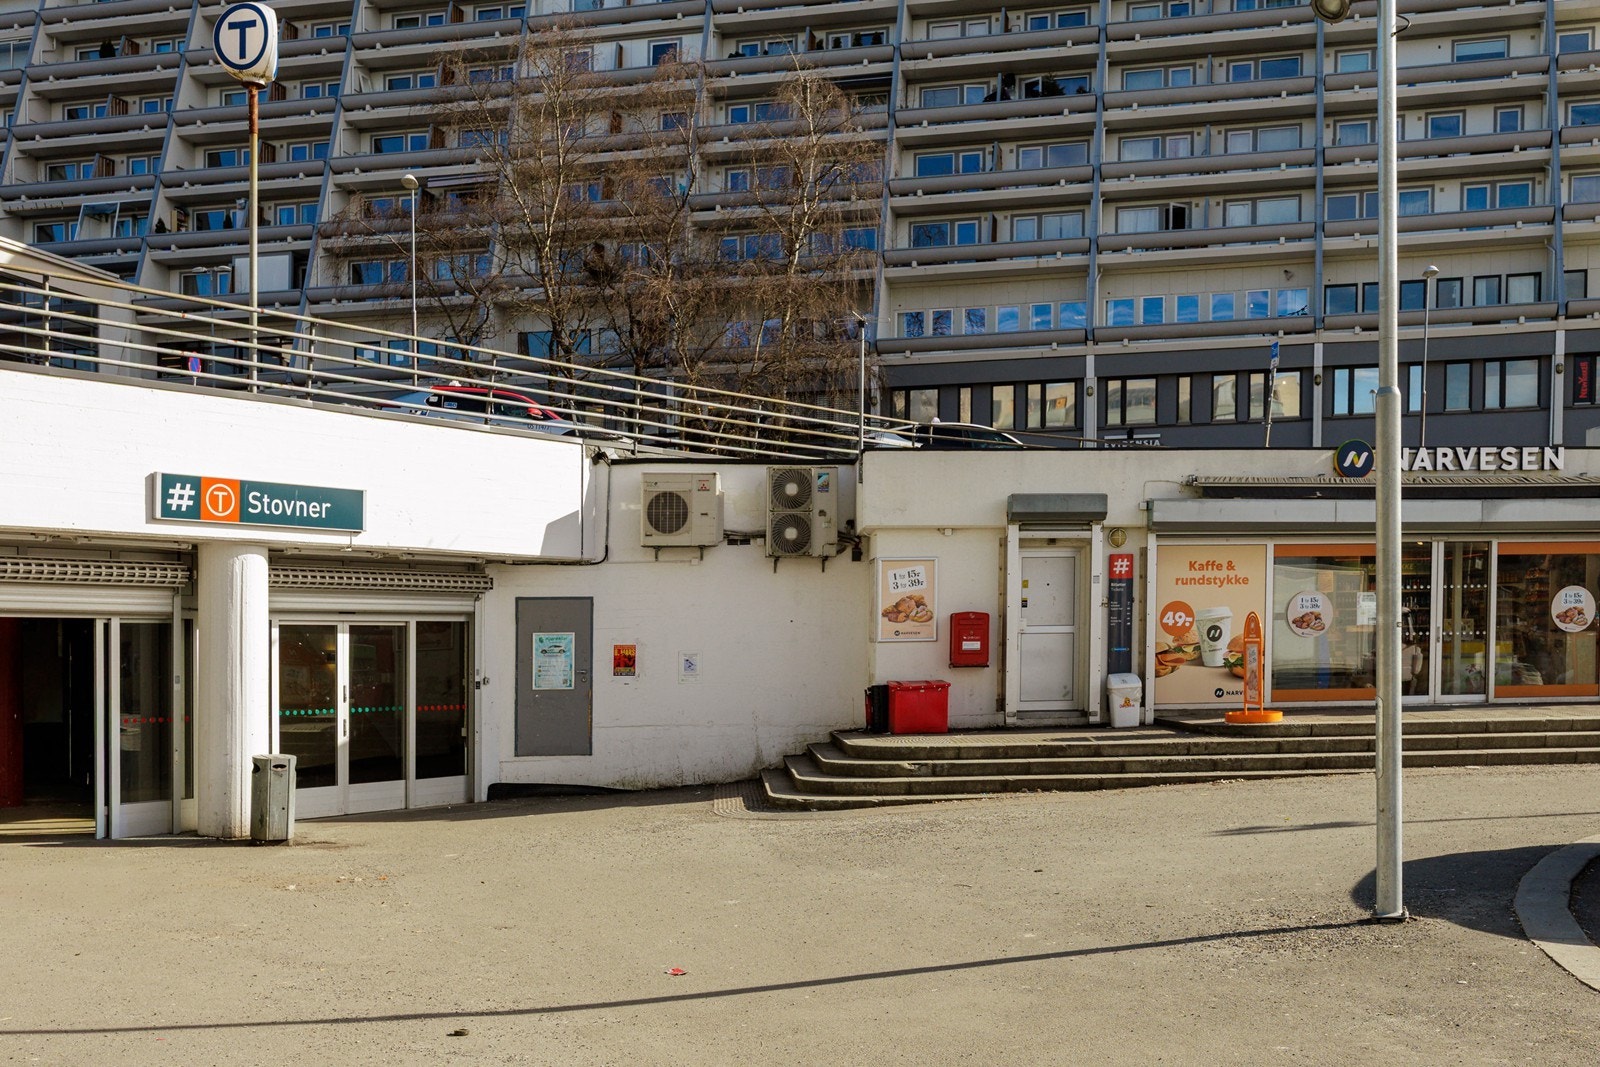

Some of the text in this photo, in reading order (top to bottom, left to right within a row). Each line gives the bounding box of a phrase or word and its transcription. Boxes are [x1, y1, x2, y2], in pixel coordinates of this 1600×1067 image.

[227, 19, 258, 60] T
[213, 491, 228, 512] T
[247, 491, 332, 519] Stovner
[1188, 560, 1236, 572] Kaffe &
[1175, 574, 1250, 588] rundstykke
